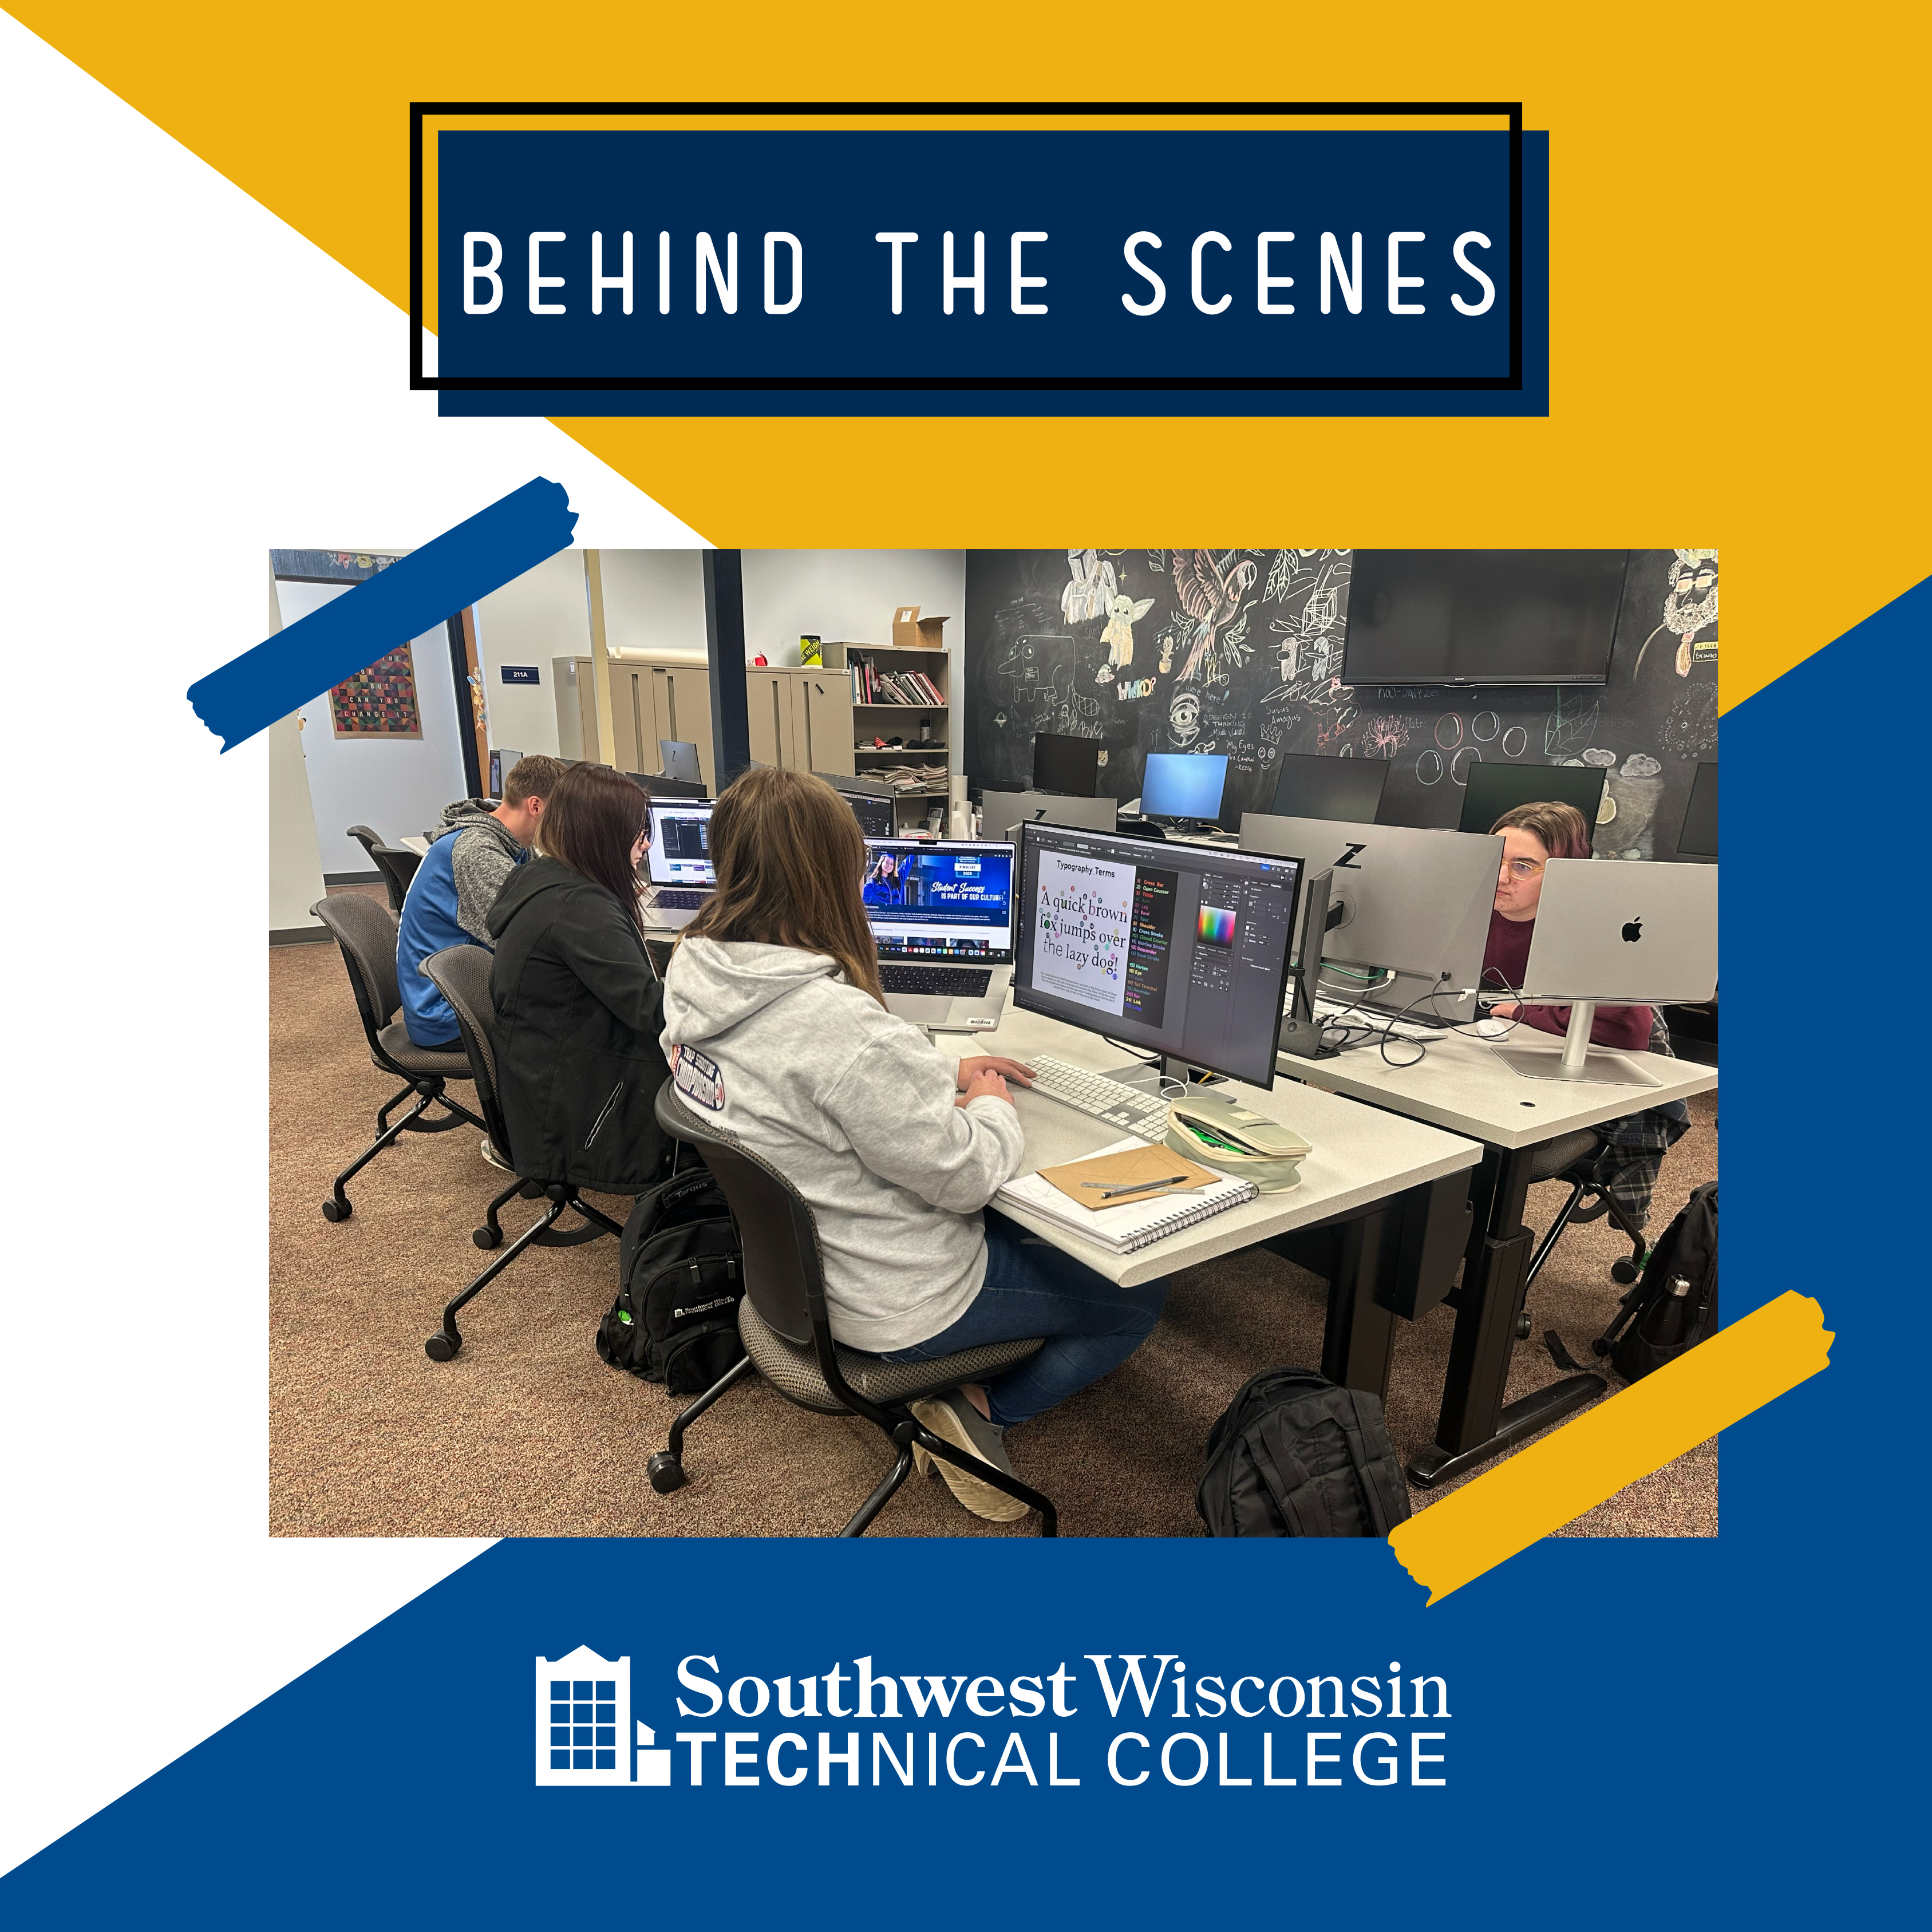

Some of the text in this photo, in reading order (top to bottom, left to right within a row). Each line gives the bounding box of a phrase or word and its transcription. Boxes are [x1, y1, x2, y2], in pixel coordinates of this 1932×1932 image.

[1186, 685, 1201, 696] were
[1266, 706, 1289, 715] Susus
[1271, 714, 1301, 730] Amogus
[1239, 740, 1254, 754] Eyes
[1056, 860, 1115, 878] Typography Terms
[931, 881, 985, 893] Student Success
[1041, 890, 1128, 923] A quick brown
[1040, 913, 1126, 948] fox jumps over
[1044, 938, 1118, 975] the lazy dog!
[1137, 947, 1157, 955] Descender
[683, 1046, 715, 1078] TRAP SHOOTING
[675, 1182, 708, 1198] Targus
